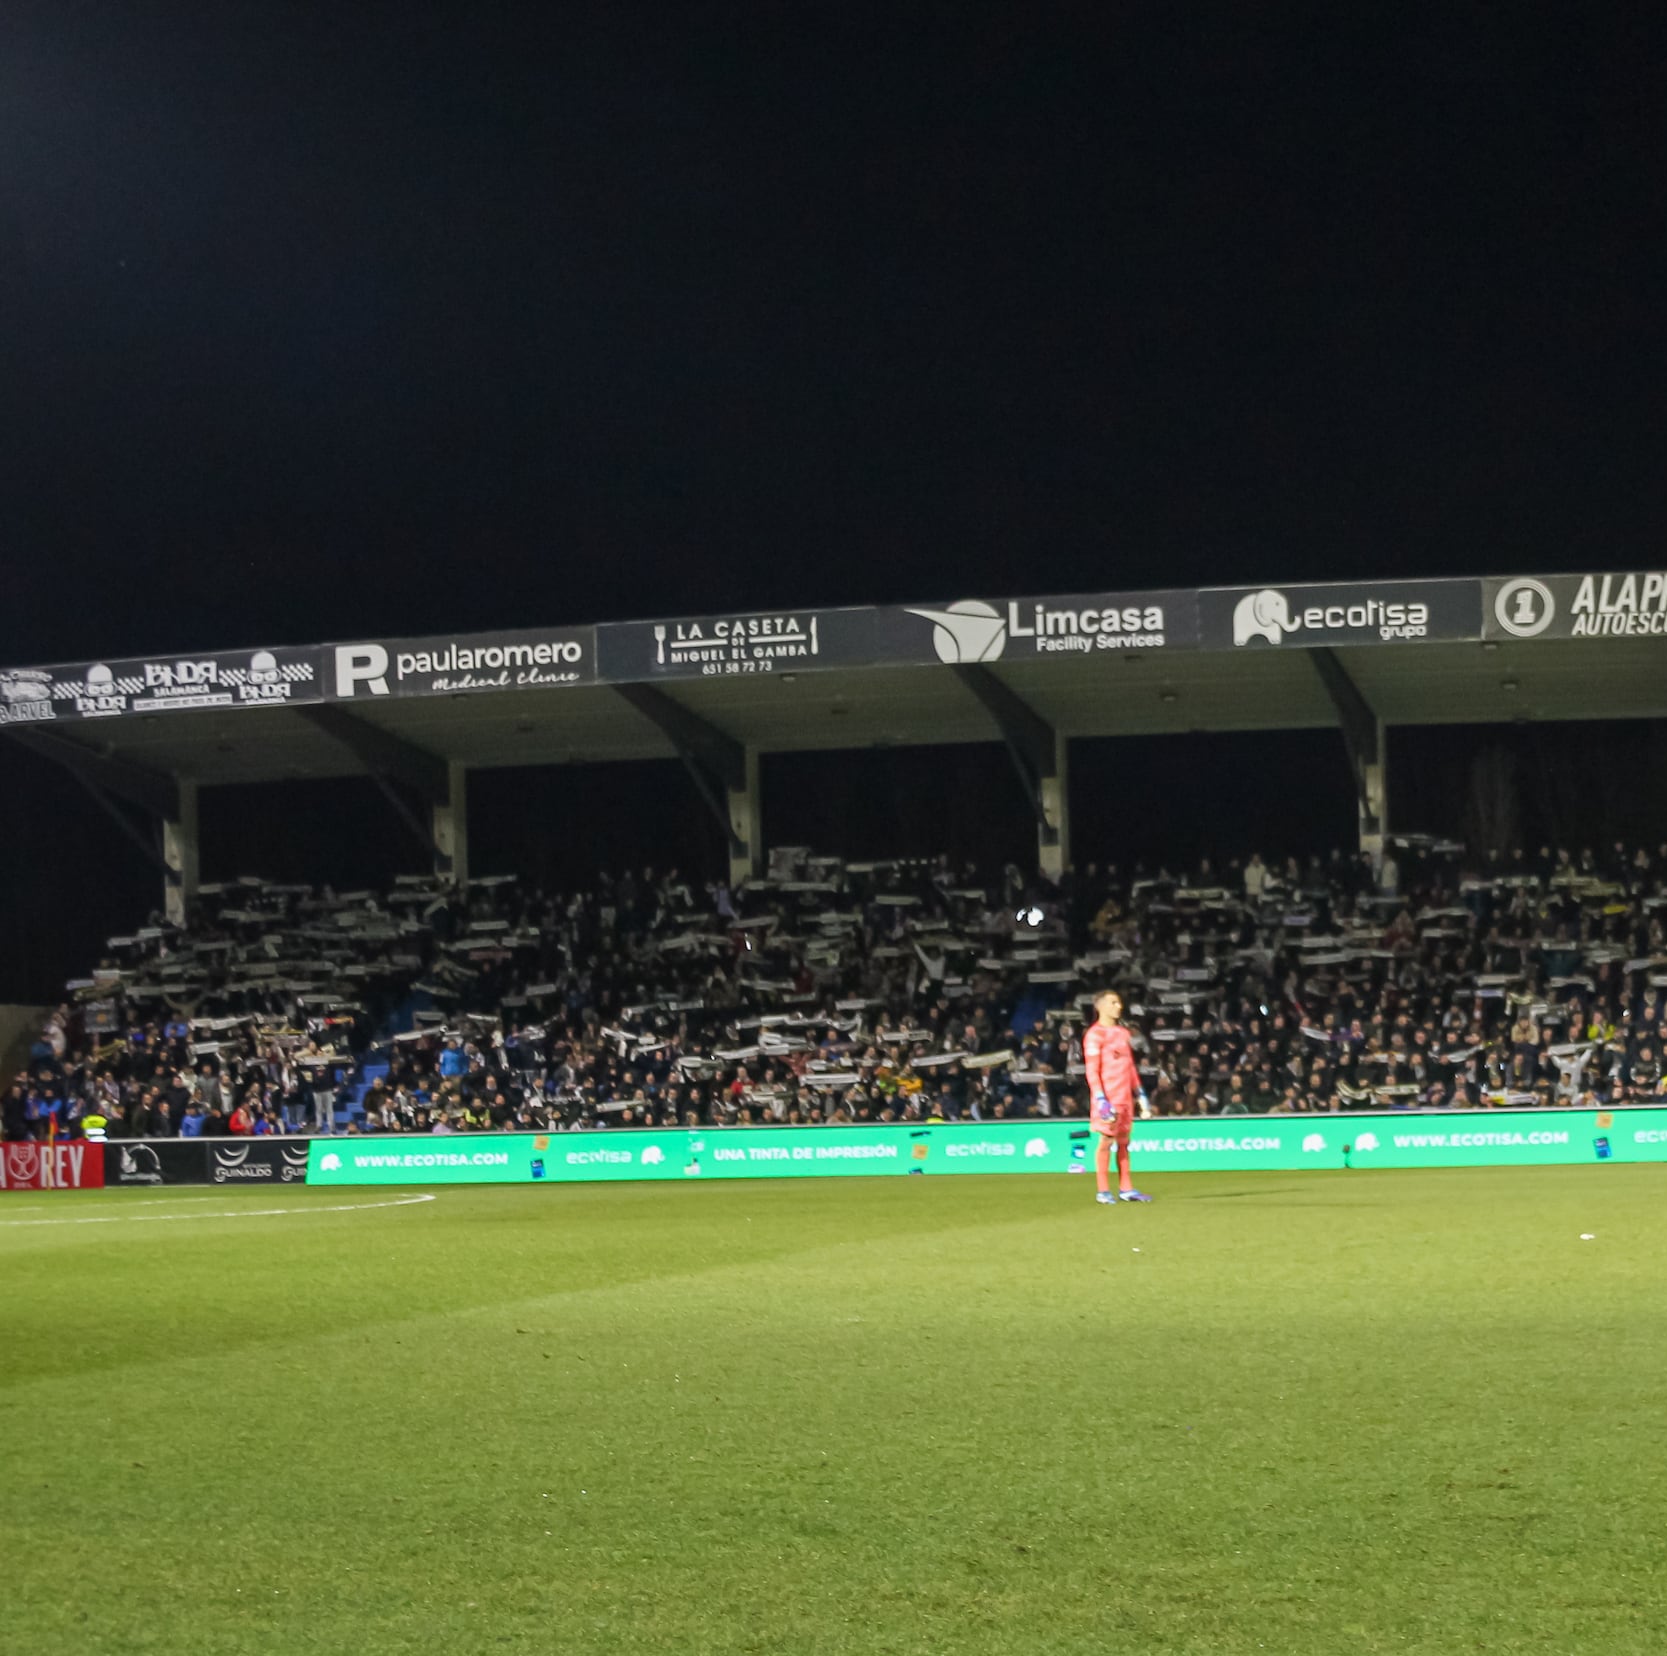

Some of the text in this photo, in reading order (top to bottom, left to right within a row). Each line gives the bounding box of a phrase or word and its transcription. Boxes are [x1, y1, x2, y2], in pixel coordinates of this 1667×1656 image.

[1008, 601, 1164, 637] Limcasa
[1303, 600, 1428, 630] ecotisa
[677, 616, 800, 641] LA CASETA
[1379, 624, 1427, 641] grupo
[732, 636, 745, 646] DE
[1037, 632, 1165, 653] Facility Services
[397, 641, 582, 680] paularomero
[671, 643, 807, 664] MIGUEL EL GAMBA
[335, 644, 390, 697] R
[742, 660, 756, 673] 72
[759, 659, 773, 672] 73
[1394, 1132, 1569, 1147] WWW.ECOTISA.COM
[567, 1149, 632, 1164] ecotisa
[714, 1143, 898, 1161] UNA TINTA DE IMPRESIÓN
[946, 1142, 1014, 1157] ecotisa
[41, 1145, 84, 1188] REY
[355, 1152, 508, 1168] WWW.ECOTISA.COM
[215, 1166, 272, 1182] GUINALDO
